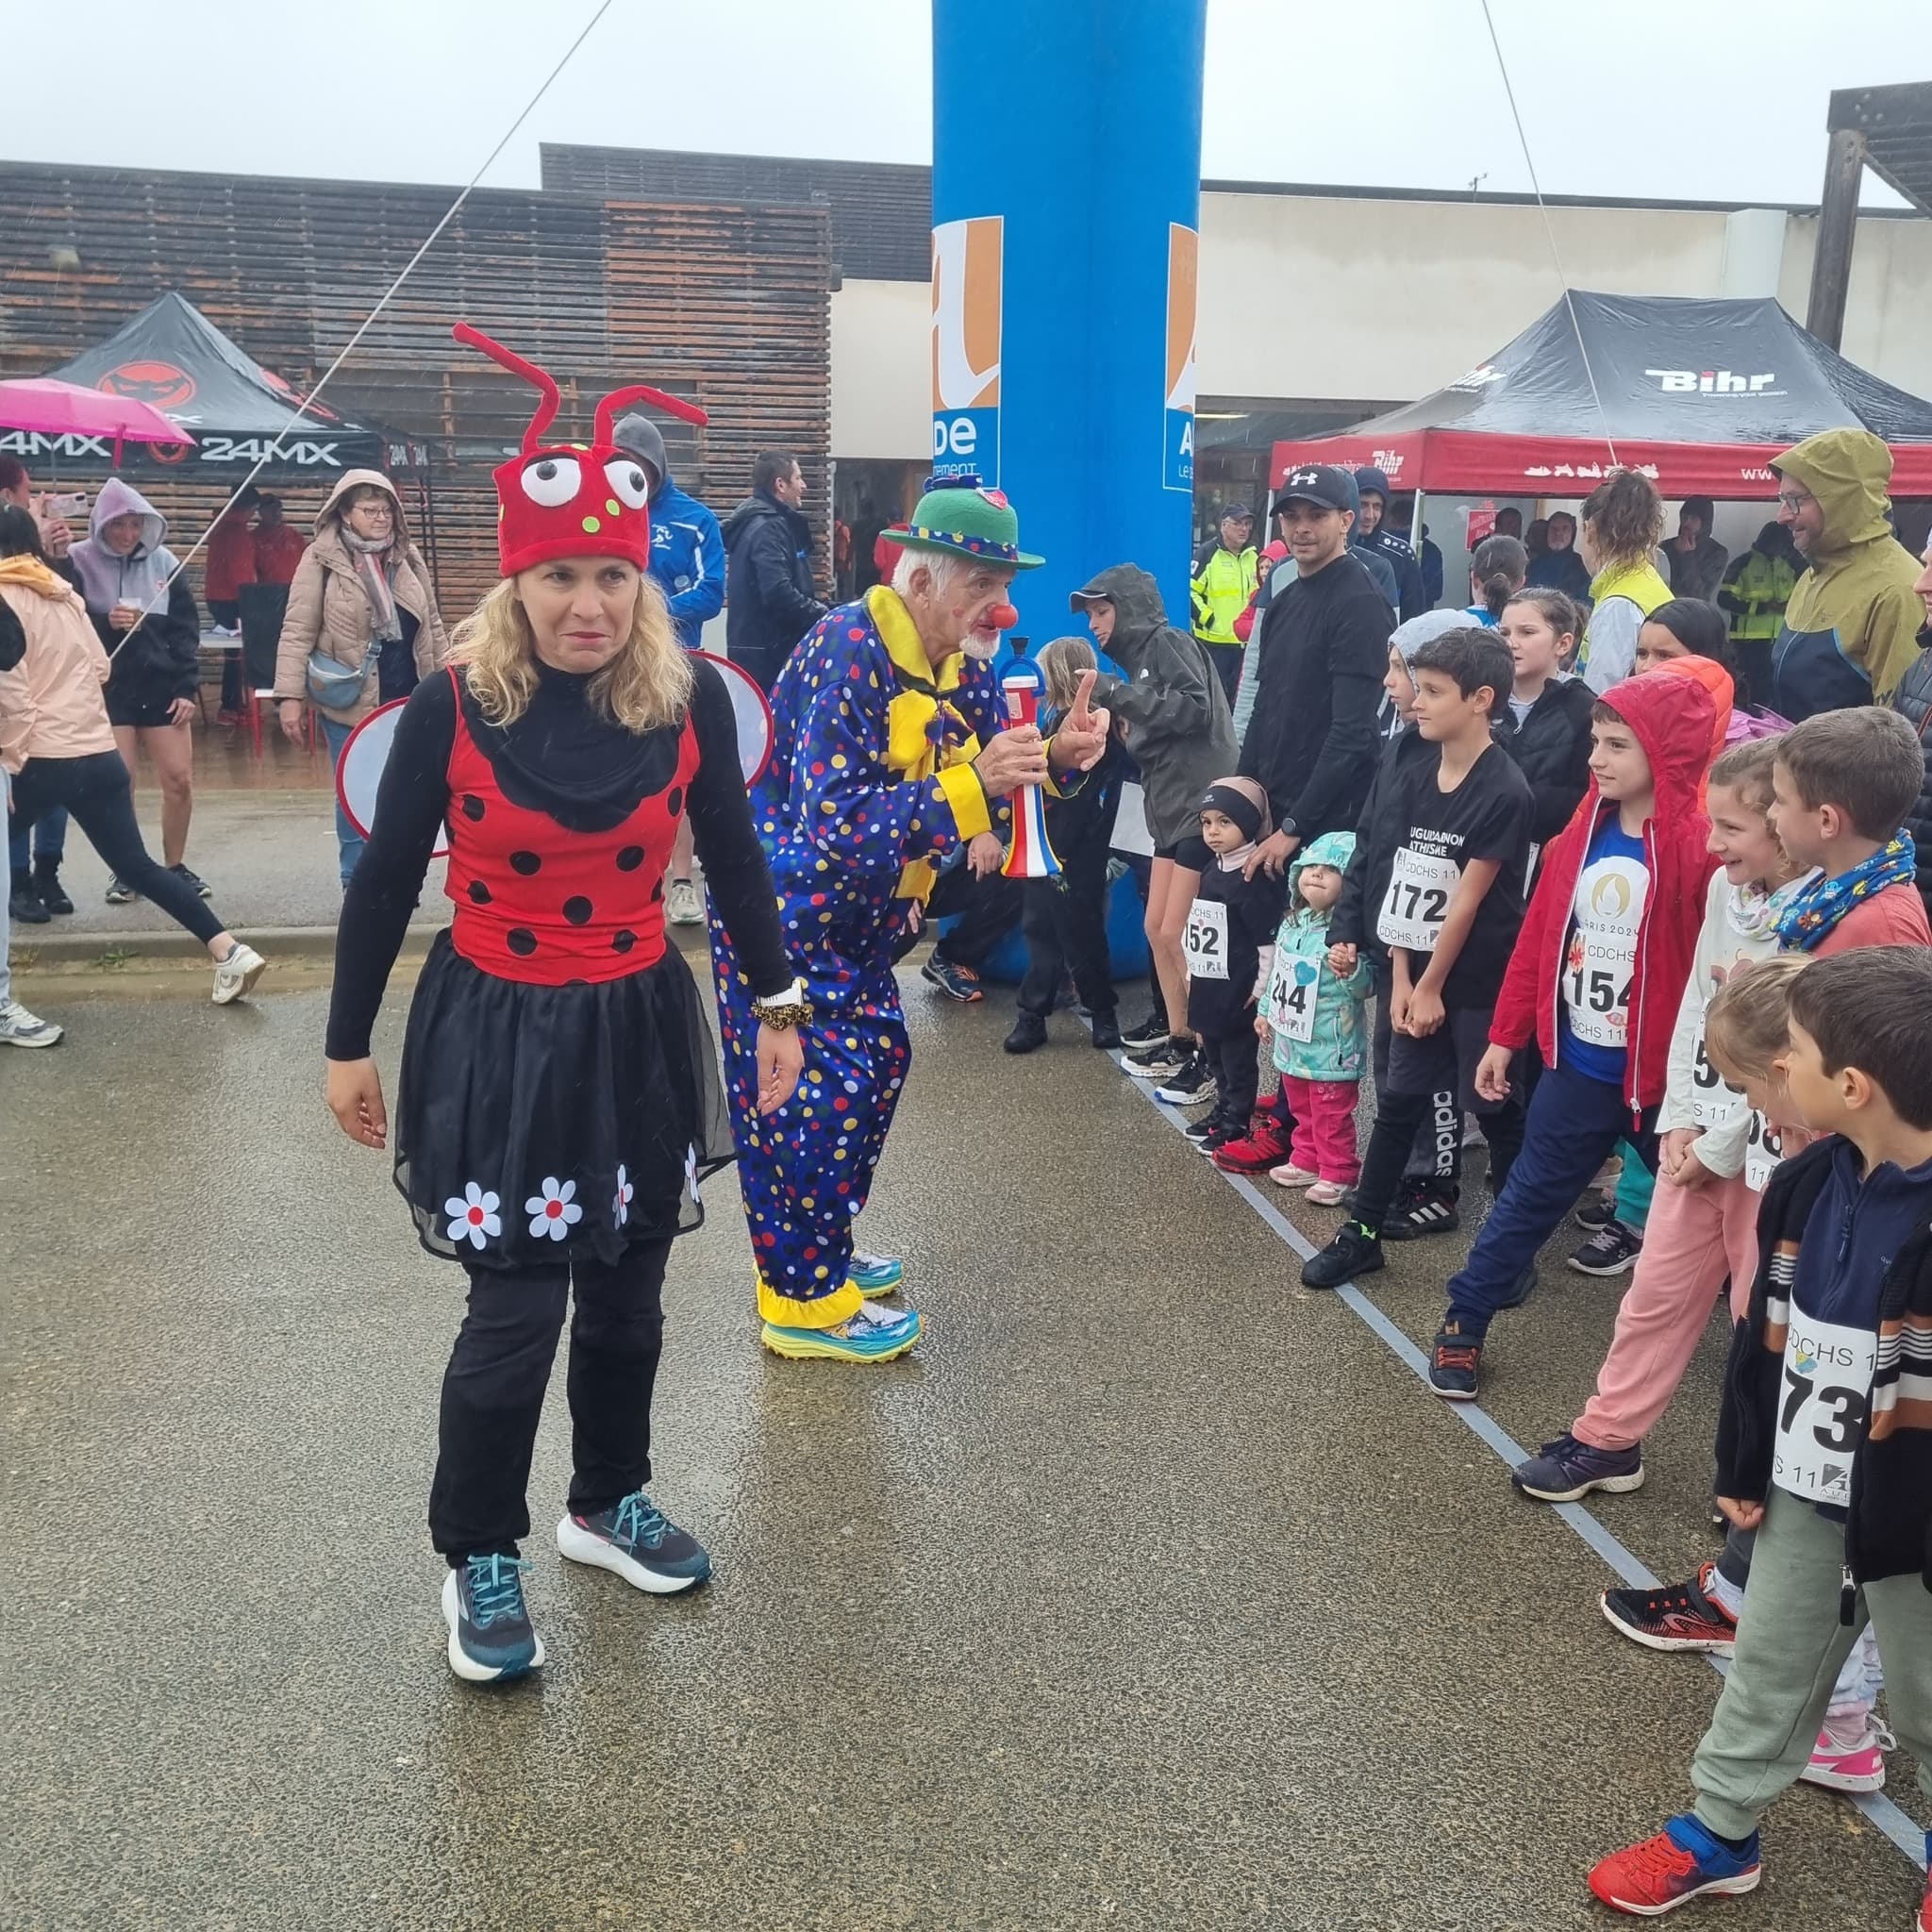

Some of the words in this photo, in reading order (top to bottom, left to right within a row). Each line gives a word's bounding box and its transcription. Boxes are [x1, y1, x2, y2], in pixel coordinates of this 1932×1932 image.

[1645, 369, 1775, 391] Bihr
[200, 437, 341, 466] 24MX
[1442, 870, 1457, 879] 11
[1390, 880, 1448, 923] 172
[1588, 944, 1636, 963] CDCHS
[1272, 972, 1307, 1015] 244
[1433, 1091, 1458, 1177] adidas
[1793, 1466, 1815, 1488] 11
